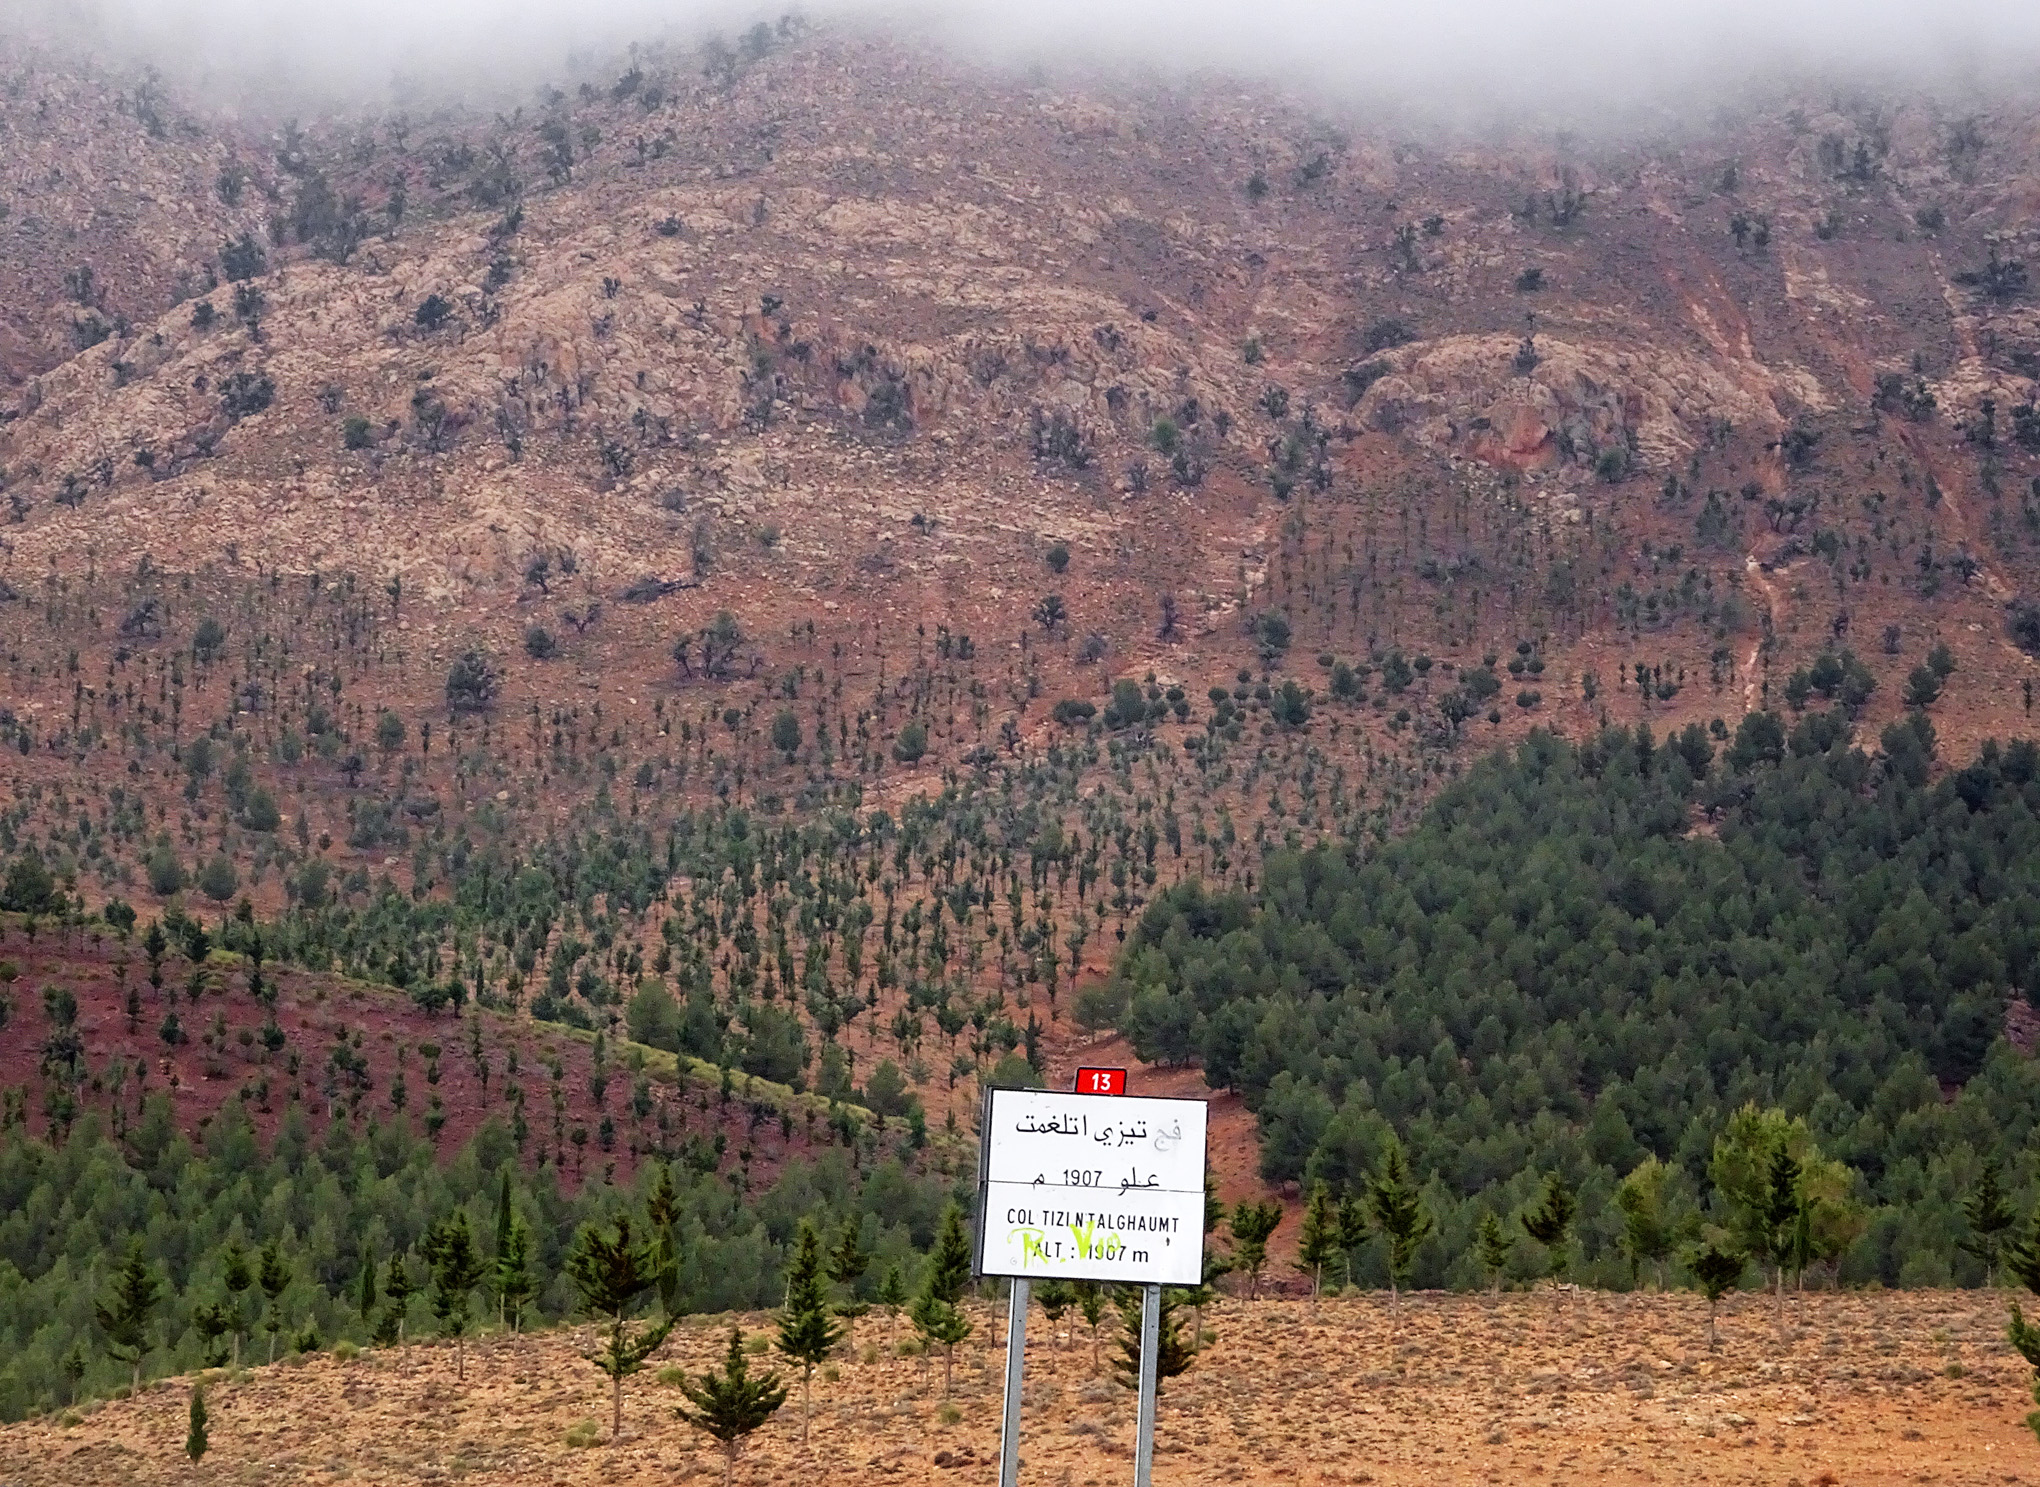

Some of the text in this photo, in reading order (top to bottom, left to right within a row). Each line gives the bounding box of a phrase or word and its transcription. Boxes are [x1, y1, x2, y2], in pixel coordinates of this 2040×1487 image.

[1091, 1073, 1111, 1091] 13
[1016, 1113, 1087, 1136] اتلغمت
[1094, 1120, 1147, 1147] تيزي
[1063, 1169, 1103, 1187] 1907
[1118, 1166, 1160, 1196] علو
[1007, 1208, 1035, 1225] COL
[1088, 1243, 1127, 1261] 1907
[1132, 1249, 1149, 1262] m
